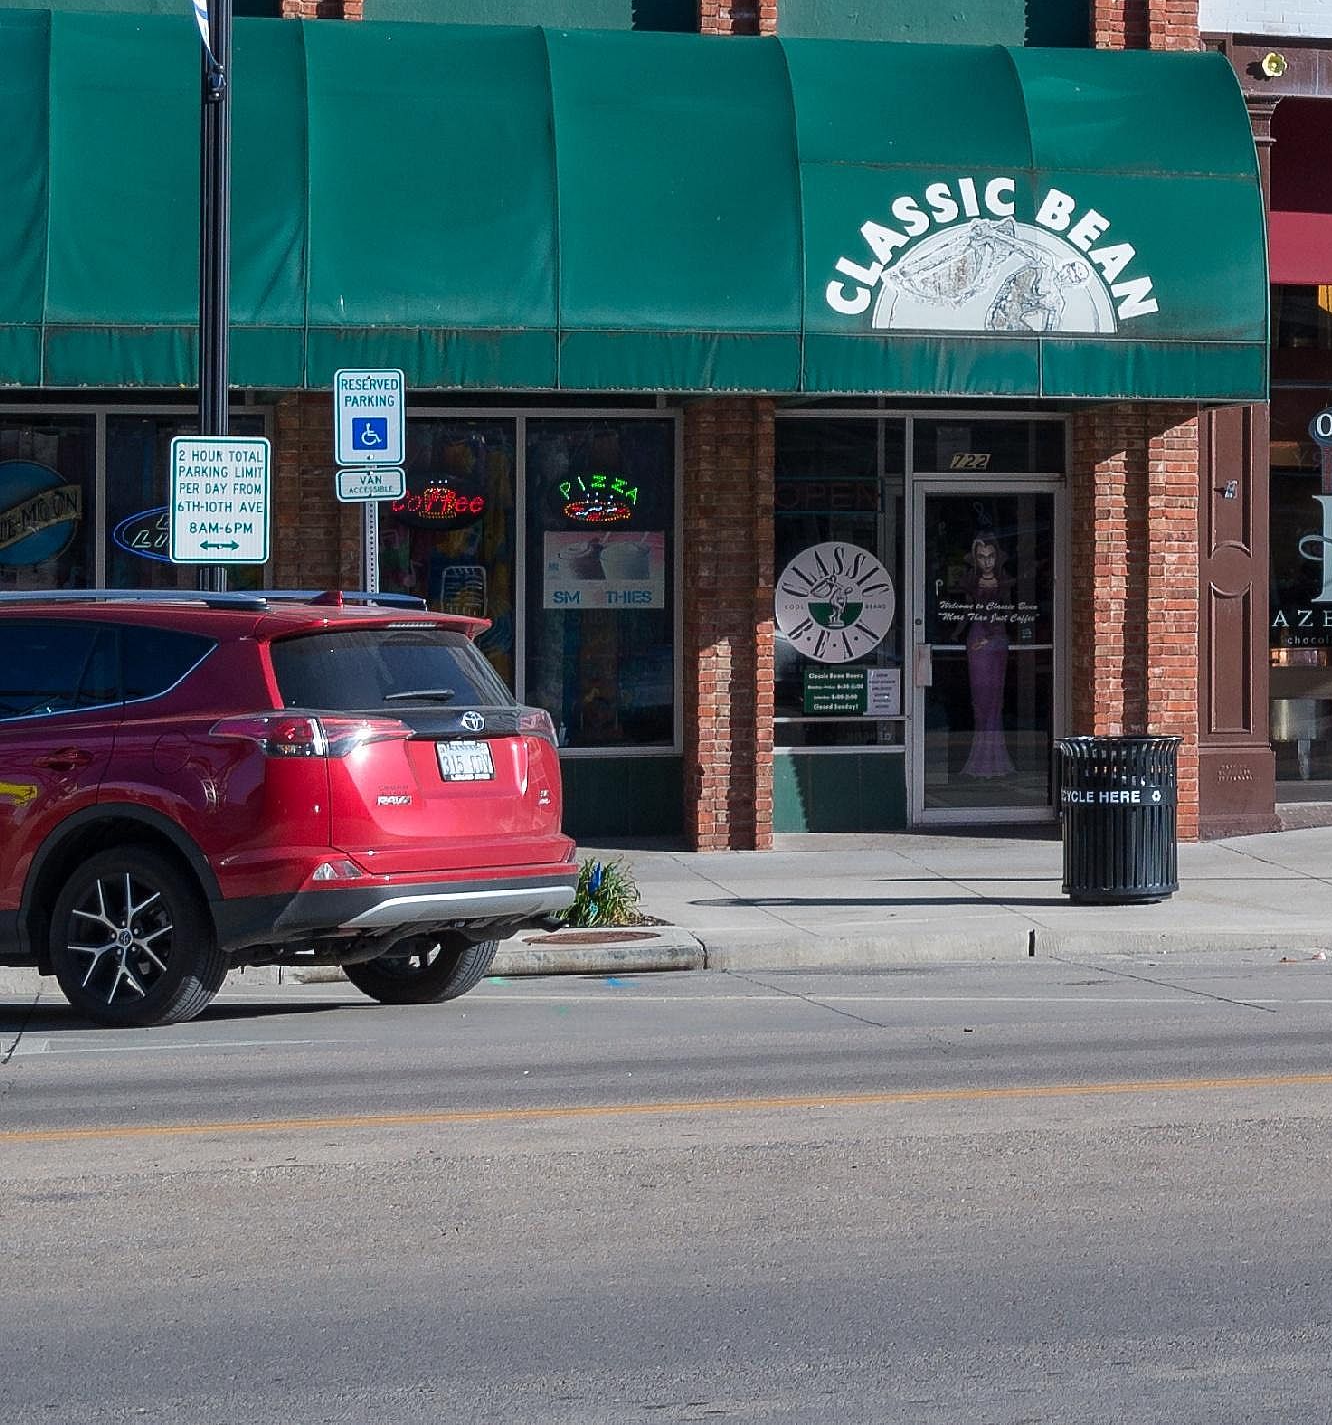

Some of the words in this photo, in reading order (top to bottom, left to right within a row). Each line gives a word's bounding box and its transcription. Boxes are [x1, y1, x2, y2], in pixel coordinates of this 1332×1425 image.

[826, 177, 1016, 315] CLASSIC
[1035, 188, 1159, 321] BEAN
[341, 377, 399, 392] RESERVED
[344, 394, 395, 408] PARKING
[178, 450, 186, 462] 2
[191, 450, 223, 462] HOUR
[229, 451, 263, 463] TOTAL
[952, 453, 990, 469] 722
[178, 466, 229, 478] PARKING
[235, 466, 263, 478] LIMIT
[359, 475, 382, 485] VAN
[179, 483, 200, 494] PER
[205, 483, 228, 495] DAY
[233, 483, 262, 495] FROM
[349, 485, 393, 494] ACCESSIBLE
[559, 474, 638, 506] PIZZA
[177, 501, 232, 513] 6TH-10TH
[239, 501, 263, 513] AVE
[189, 522, 253, 535] 8AM-6PM
[781, 546, 890, 598] CLASSIC
[1099, 790, 1141, 804] HERE
